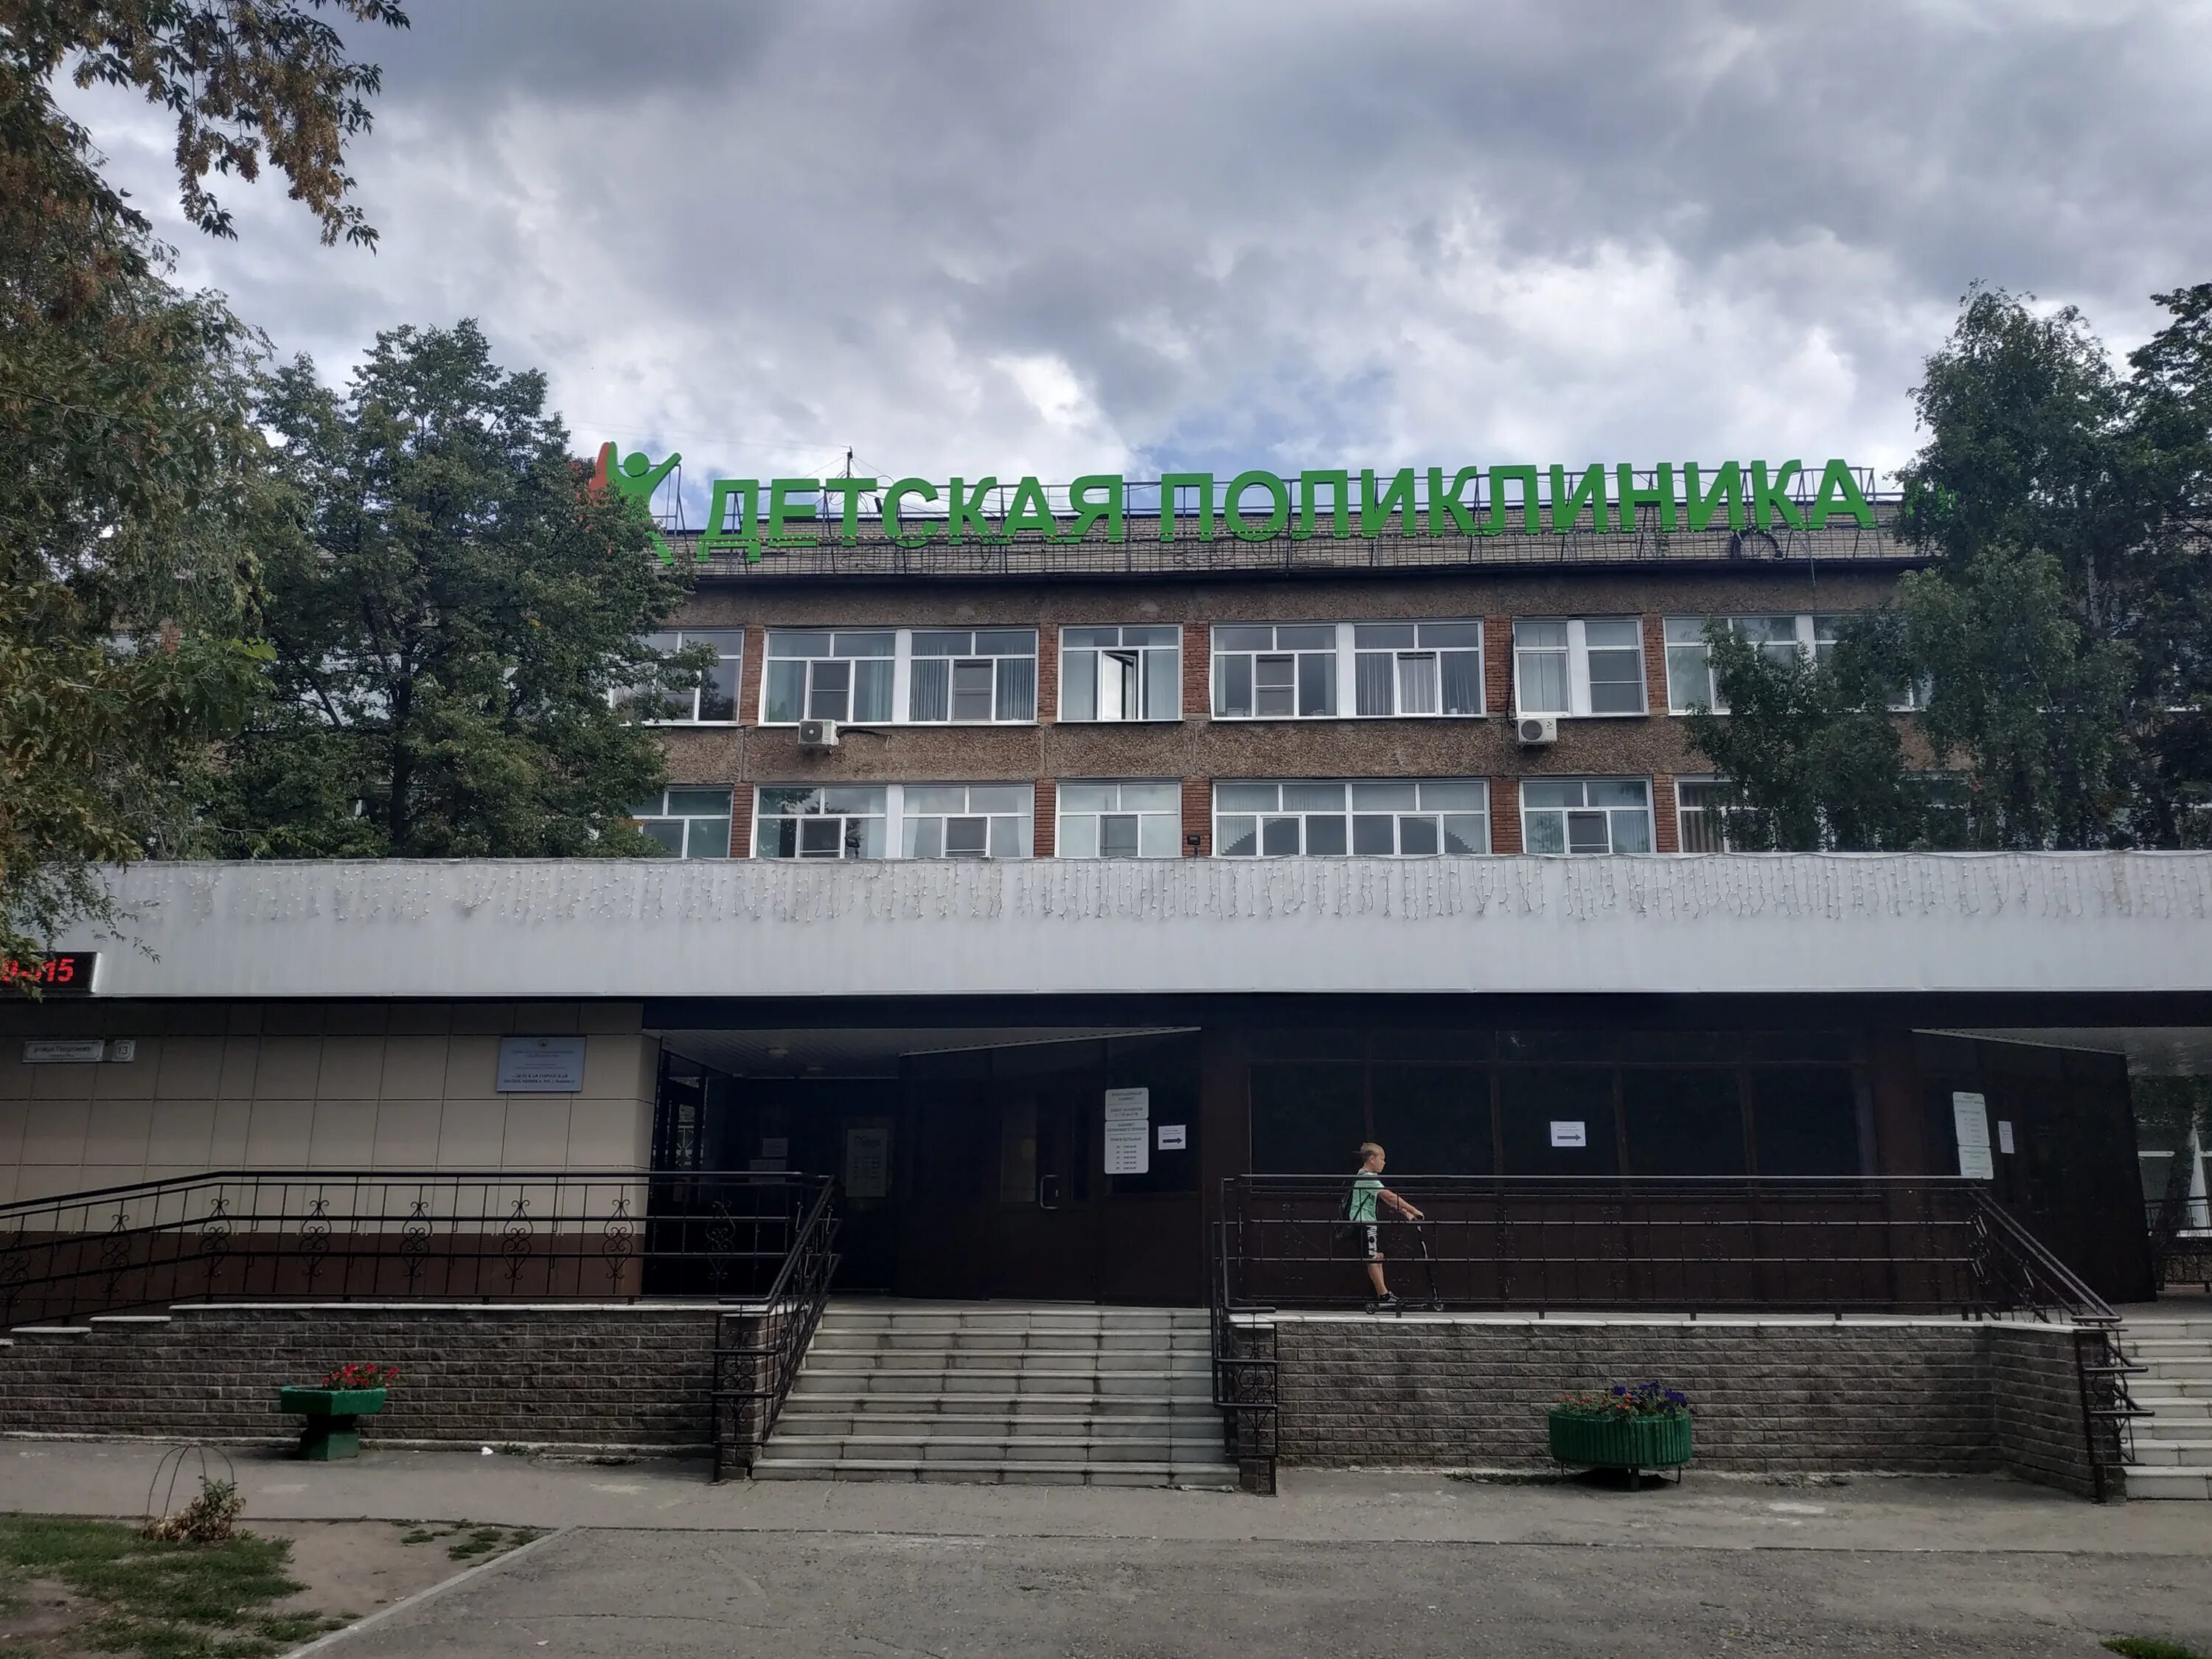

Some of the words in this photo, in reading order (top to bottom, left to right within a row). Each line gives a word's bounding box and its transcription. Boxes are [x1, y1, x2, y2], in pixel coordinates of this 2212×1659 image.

[696, 474, 1124, 564] ДЕТСКАЯ
[1160, 458, 1875, 543] ПОЛИКЛИНИКА
[117, 1046, 128, 1055] 13
